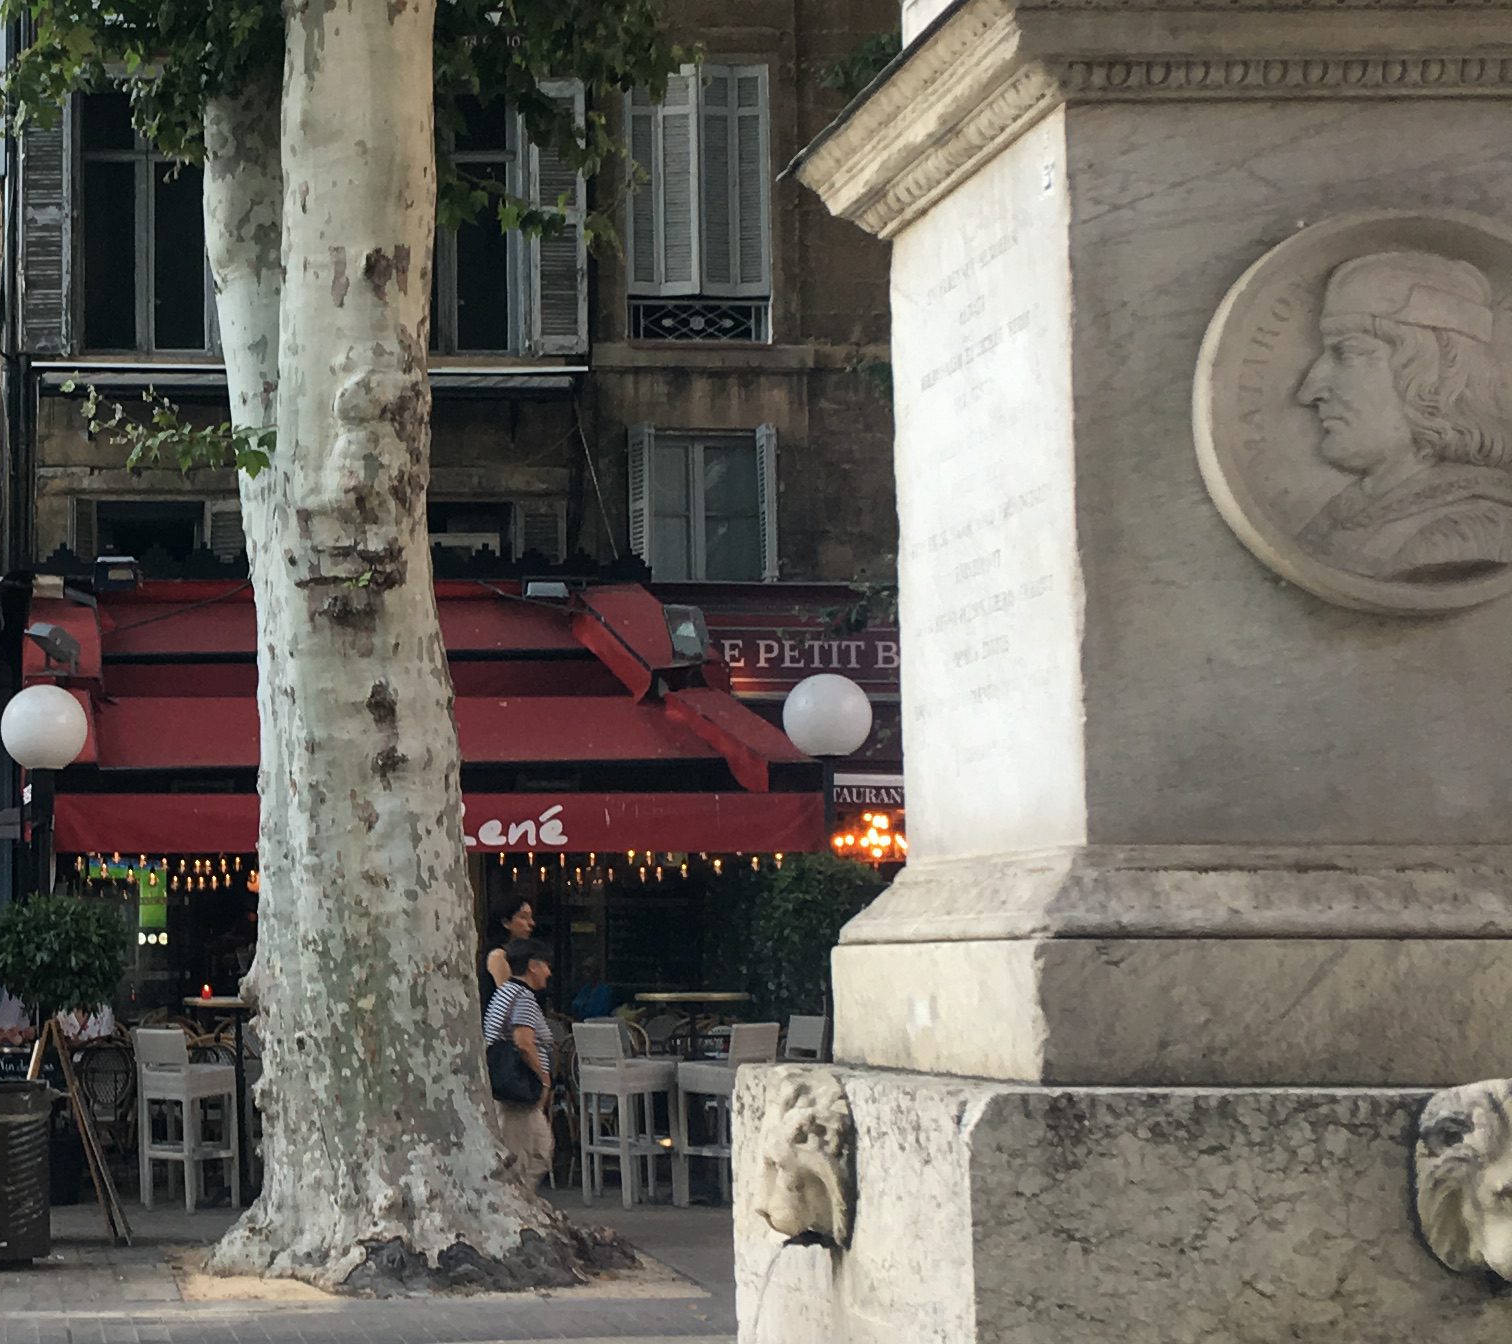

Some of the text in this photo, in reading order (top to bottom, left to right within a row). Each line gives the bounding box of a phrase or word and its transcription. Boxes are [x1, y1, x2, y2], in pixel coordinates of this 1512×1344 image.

[756, 639, 865, 668] PETIT
[833, 787, 904, 804] TAURAN
[461, 801, 568, 847] ené
